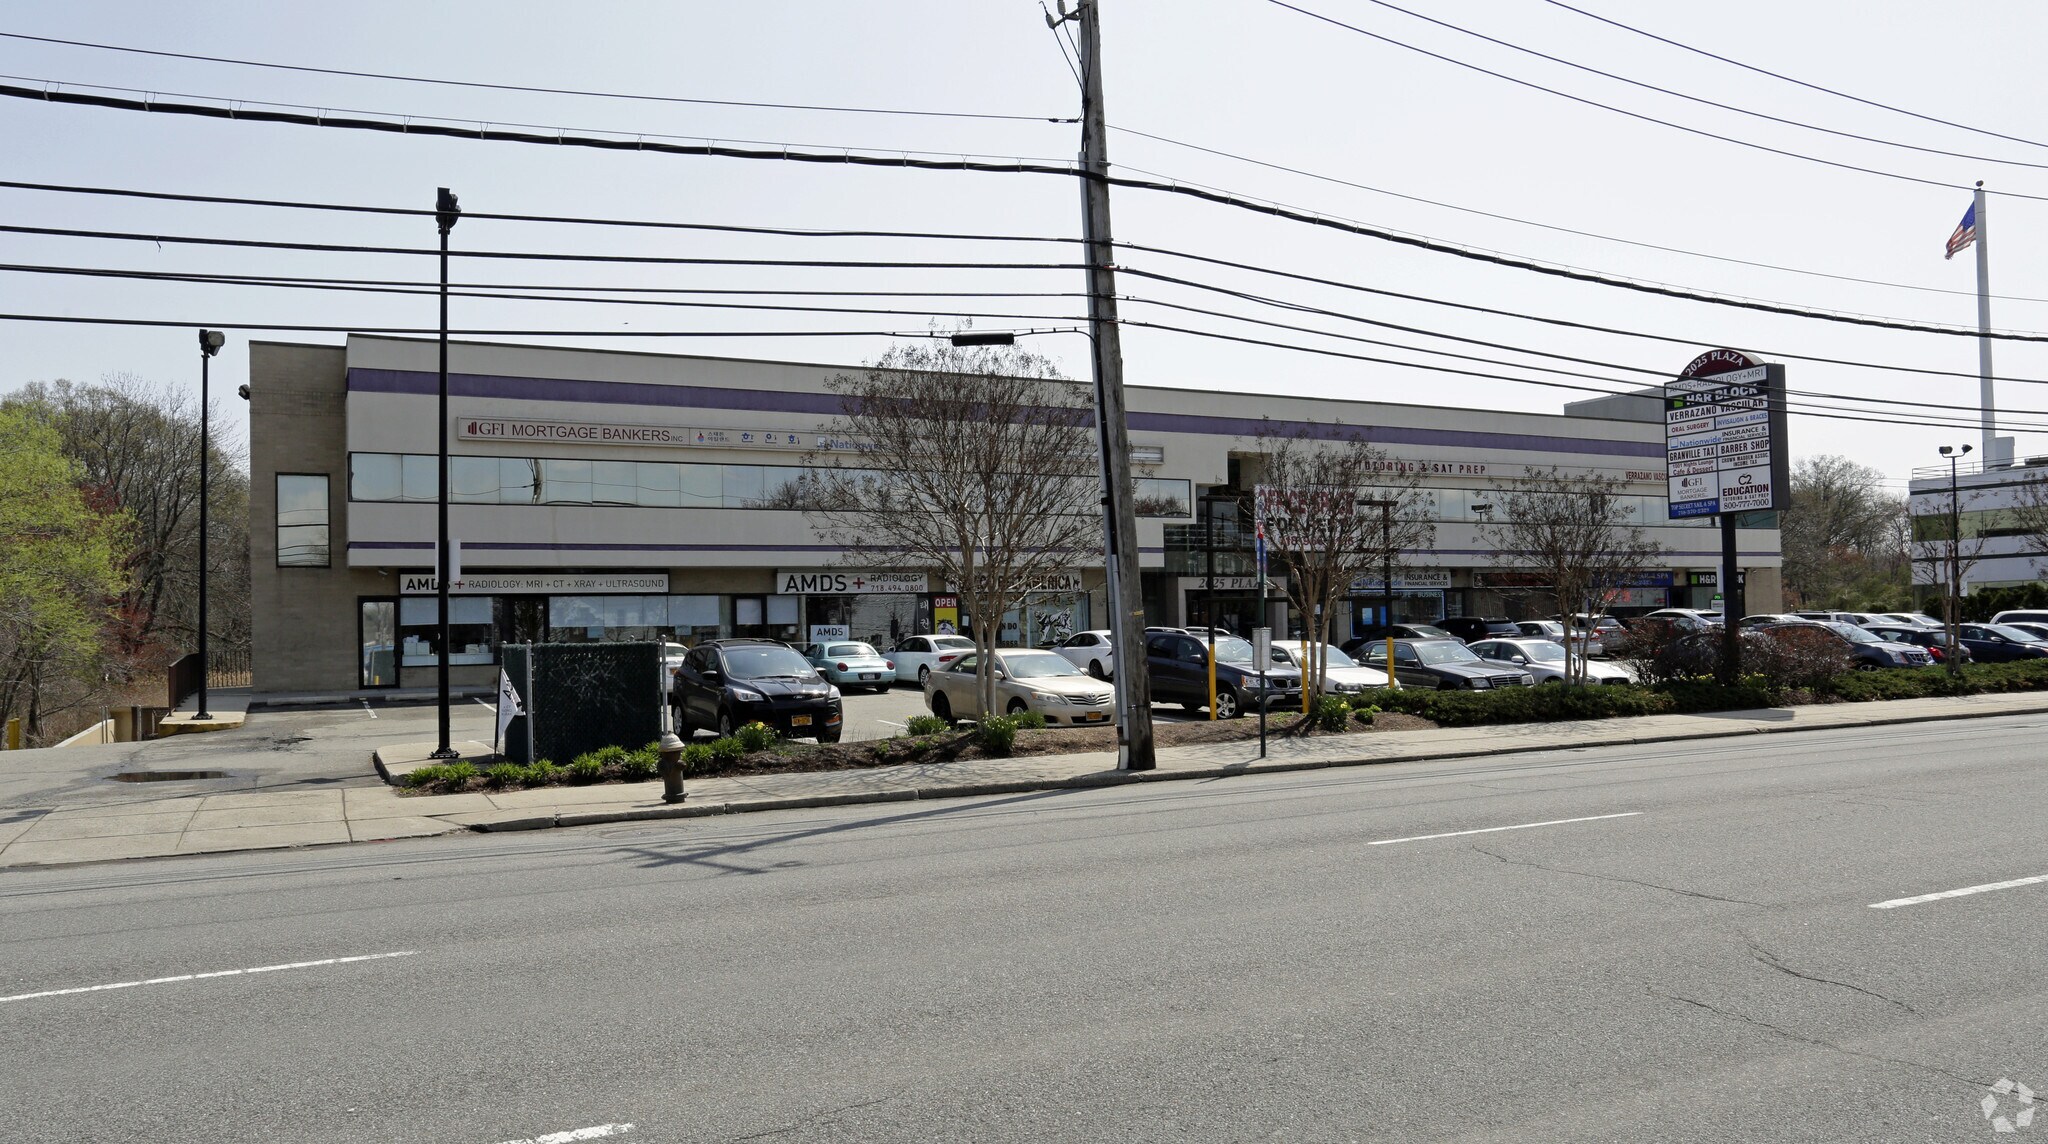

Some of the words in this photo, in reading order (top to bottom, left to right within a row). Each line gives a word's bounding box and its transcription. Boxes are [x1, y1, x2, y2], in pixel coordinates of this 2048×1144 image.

[1686, 356, 1708, 376] 2025
[1711, 351, 1744, 367] PLAZA
[1670, 406, 1717, 421] VERRAZANO
[1749, 412, 1768, 421] BRACES
[1671, 425, 1685, 433] ORAL
[1686, 422, 1710, 431] SURGERY
[1721, 427, 1759, 437] INSURANCE
[479, 424, 505, 436] GFI
[512, 424, 598, 440] MORTGAGE
[602, 428, 671, 443] BANKERS
[1679, 436, 1722, 447] Nationwide
[1721, 443, 1748, 454] BARBER
[1750, 440, 1770, 450] SHOP
[1670, 450, 1701, 461] GRANVILLE
[1703, 447, 1715, 457] TAX
[1433, 464, 1452, 474] SAT
[1459, 465, 1486, 474] PREP
[1692, 466, 1714, 474] Dessert
[1625, 471, 1652, 480] VERRAZANO
[1688, 477, 1702, 487] GFI
[1677, 487, 1708, 495] MORTGAGE
[1722, 484, 1769, 496] EDUCATION
[1724, 498, 1770, 510] 800-777-7000
[870, 574, 924, 582] RADIOLOGY
[1404, 572, 1440, 581] INSURANCE
[1699, 575, 1716, 584] H&R
[468, 580, 524, 589] RADIOLOGY:
[526, 580, 543, 588] MRI
[552, 580, 565, 589] CT
[574, 580, 596, 588] XRAY
[605, 579, 664, 588] ULTRASOUND
[785, 574, 847, 592] AMDS
[870, 584, 924, 592] 718.494.0800
[935, 598, 957, 608] OPEN
[816, 627, 844, 636] AMDS
